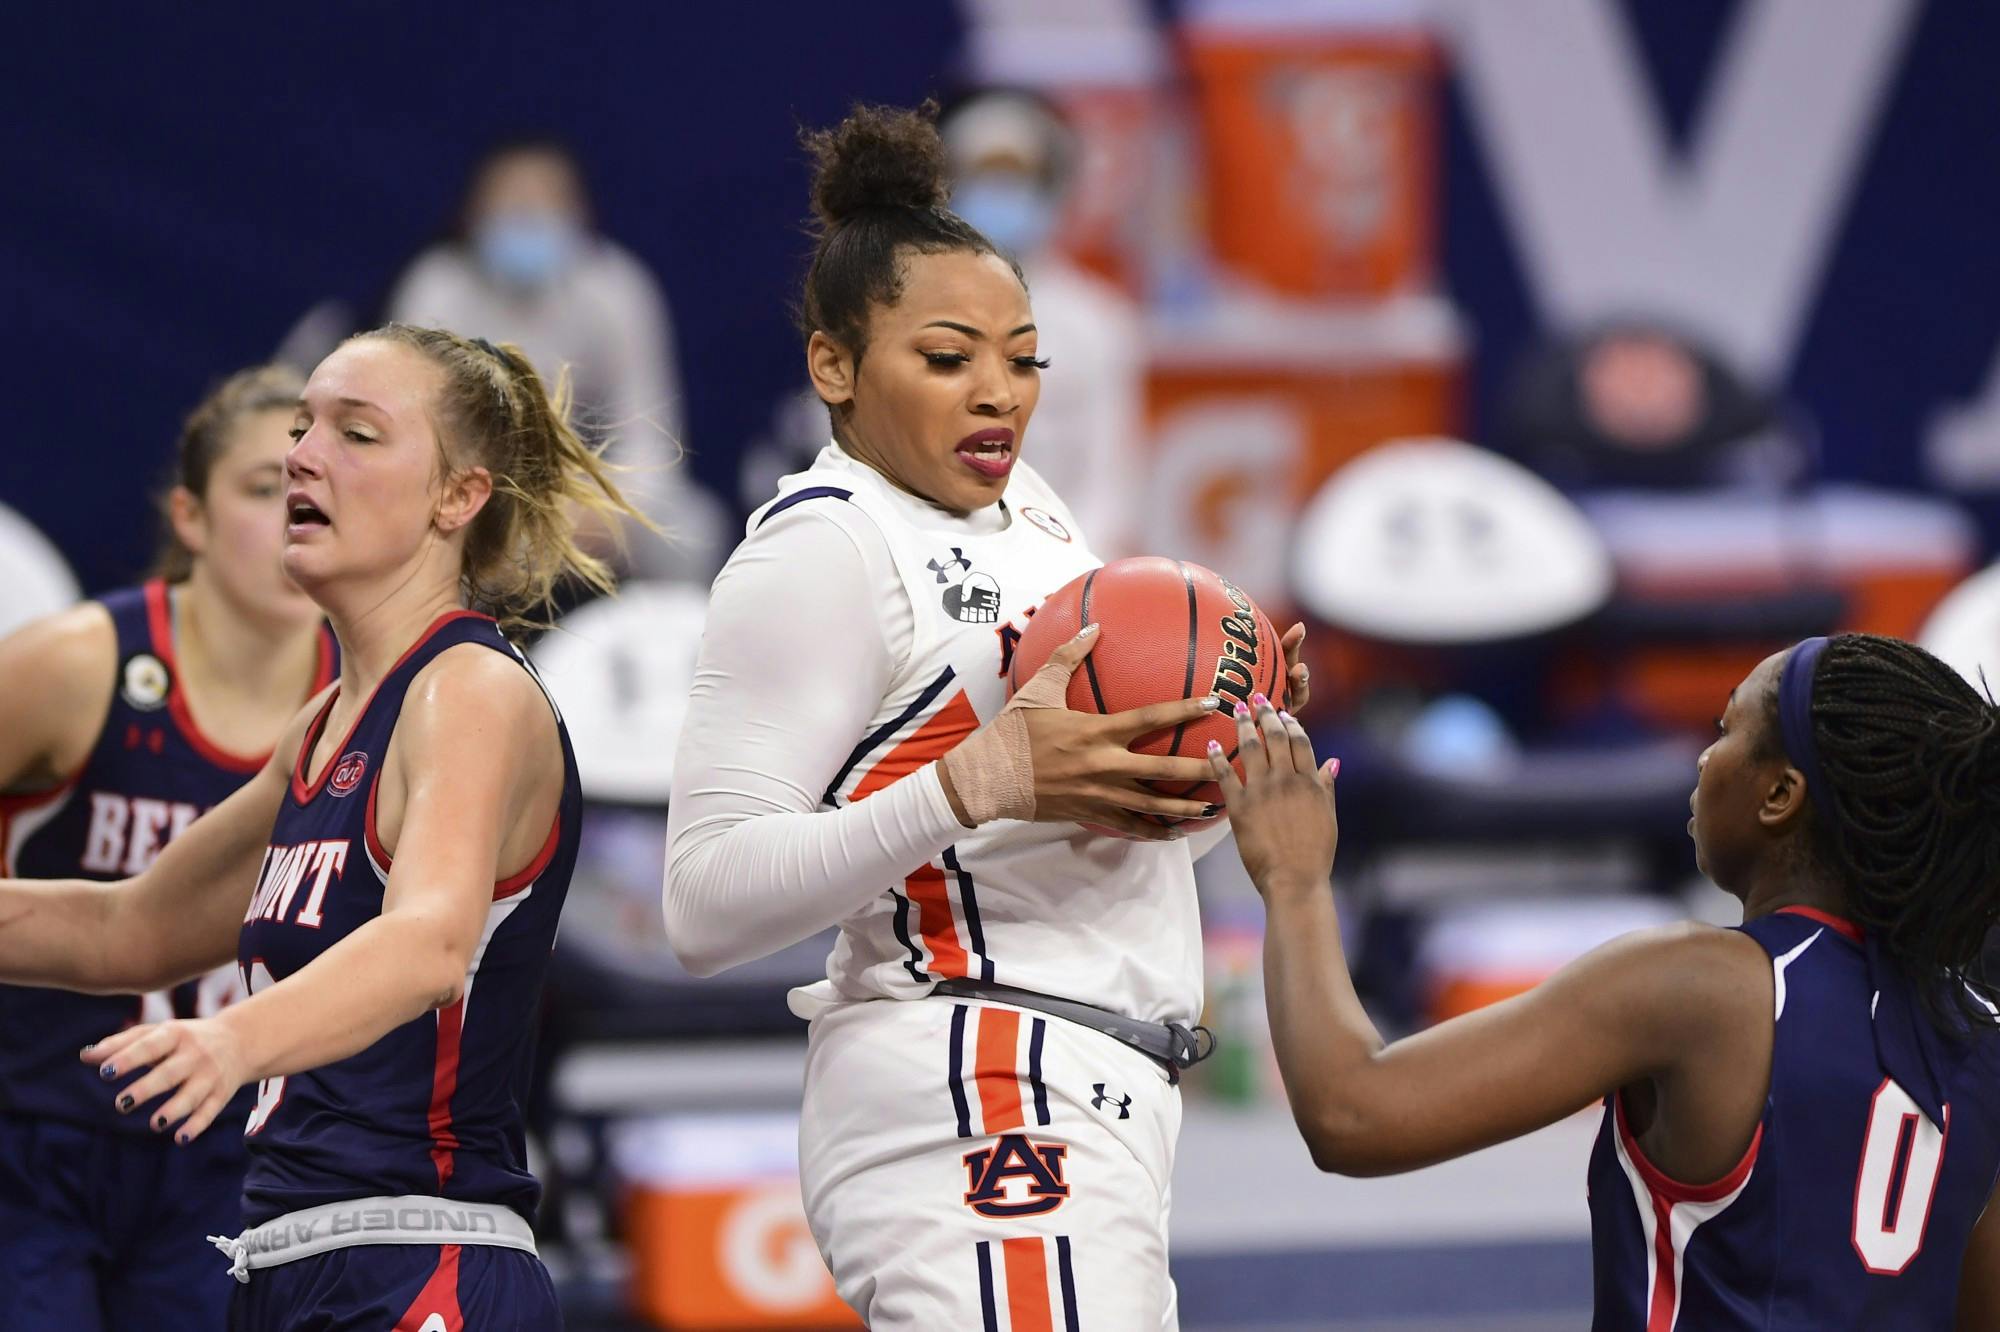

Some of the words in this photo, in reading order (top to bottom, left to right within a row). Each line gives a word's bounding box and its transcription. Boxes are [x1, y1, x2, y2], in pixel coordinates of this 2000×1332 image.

[1850, 1074, 1951, 1277] 0
[243, 1218, 320, 1256] ARM
[331, 1208, 497, 1236] UNDER
